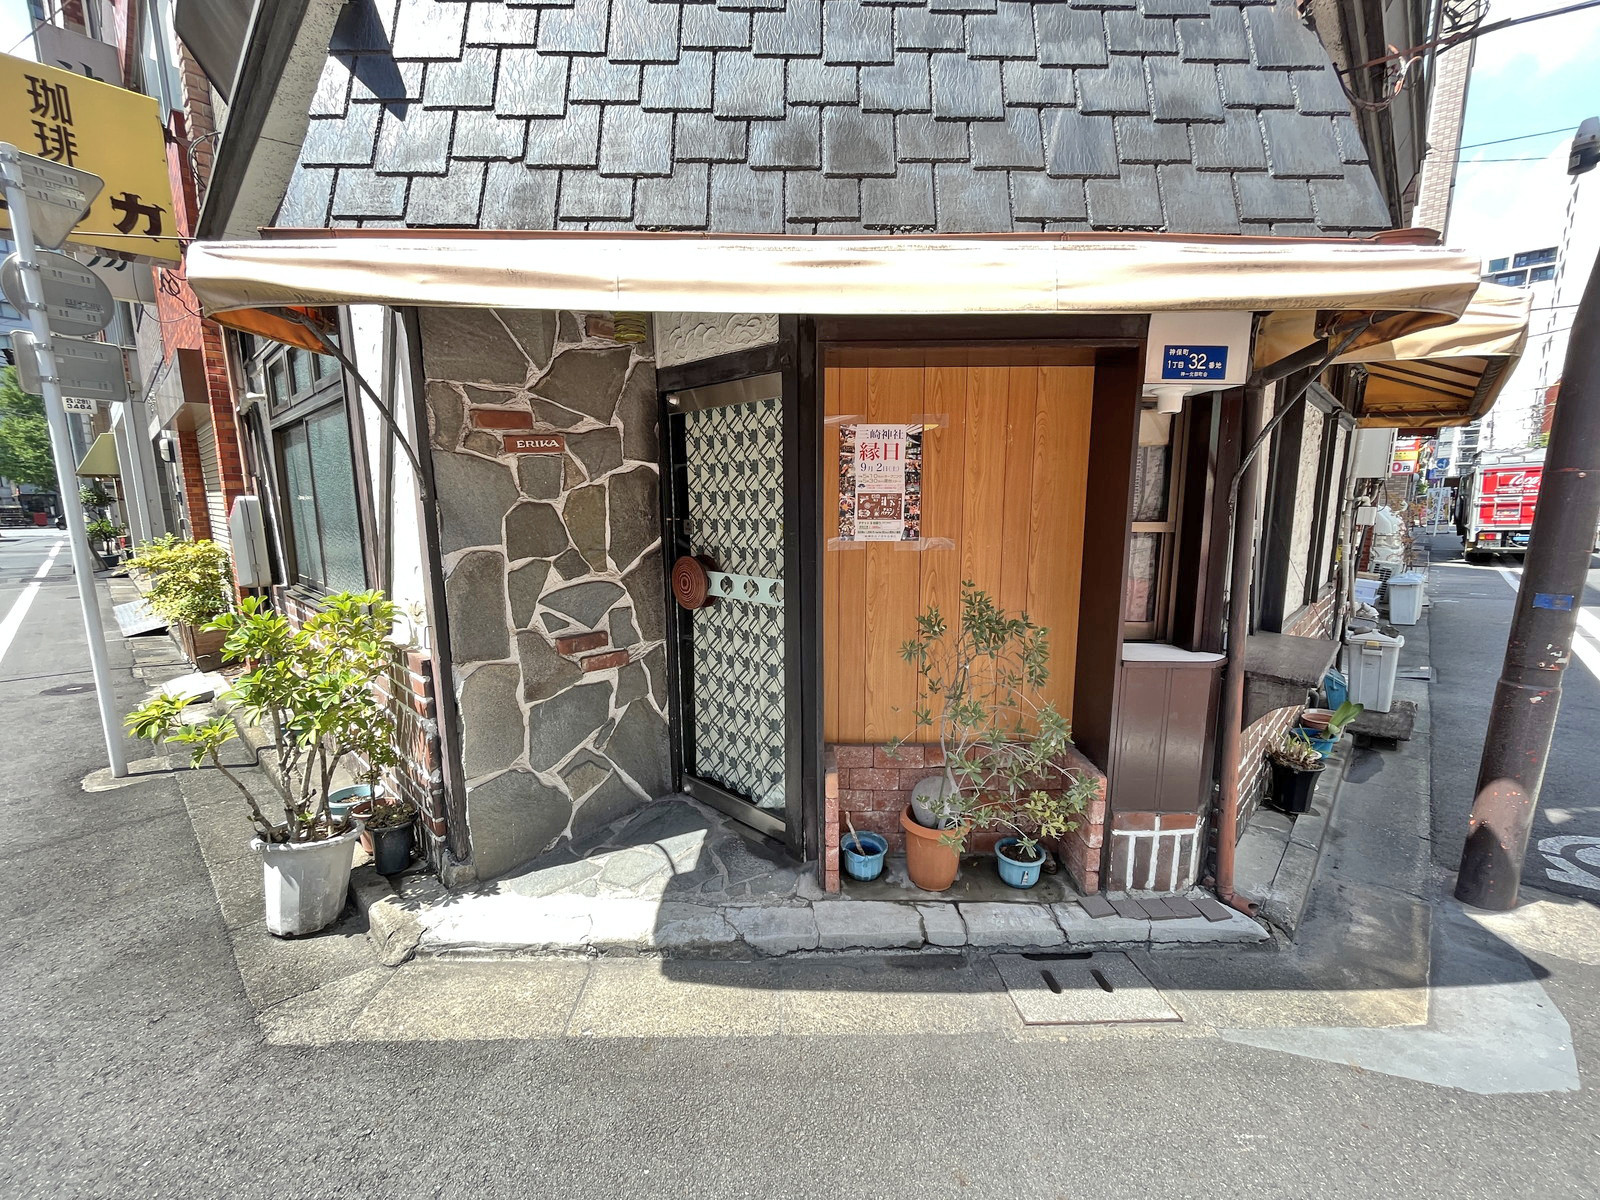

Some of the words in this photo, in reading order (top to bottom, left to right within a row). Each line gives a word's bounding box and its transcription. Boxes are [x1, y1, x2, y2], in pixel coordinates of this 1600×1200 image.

[24, 74, 79, 167] 珈琲
[1168, 360, 1184, 368] 1丁目
[1189, 353, 1207, 369] 32
[516, 439, 560, 448] ERIKA
[859, 442, 899, 460] 縁日
